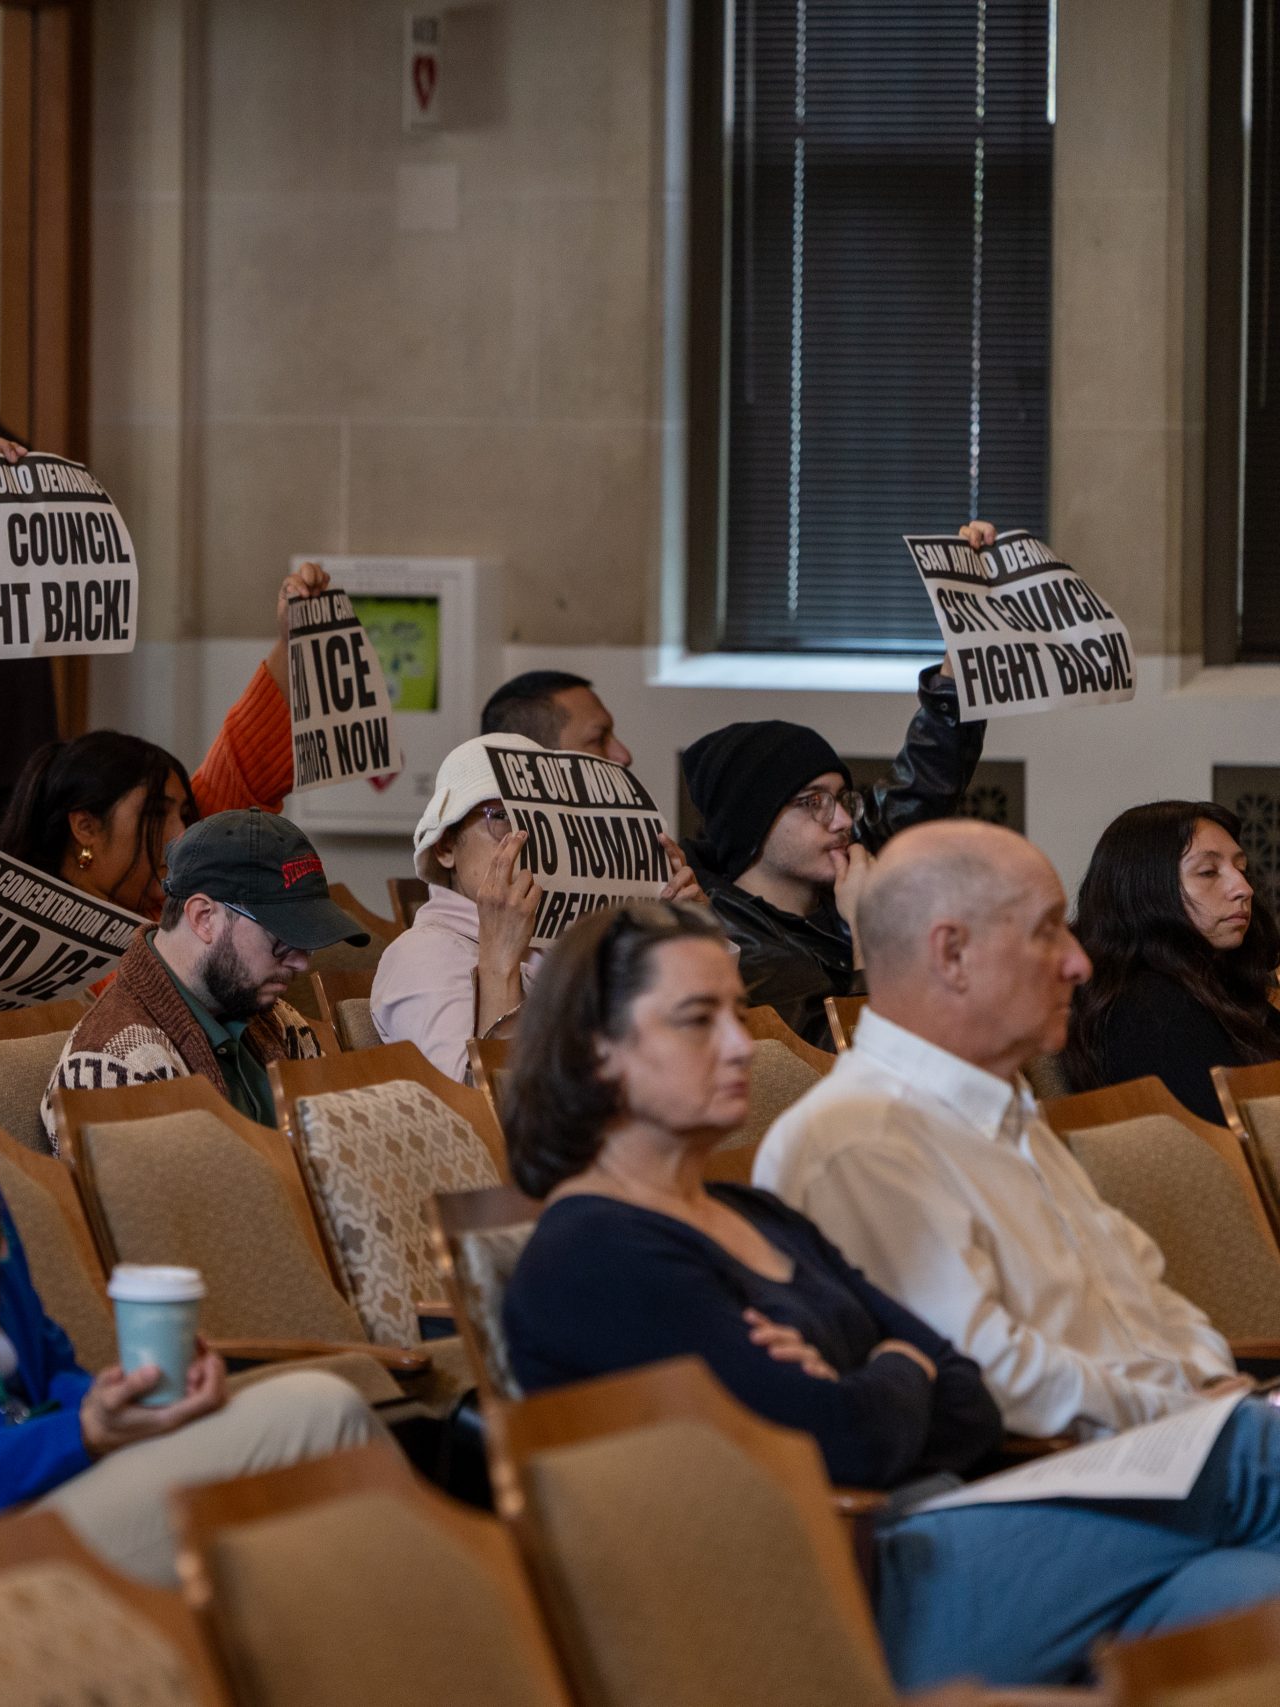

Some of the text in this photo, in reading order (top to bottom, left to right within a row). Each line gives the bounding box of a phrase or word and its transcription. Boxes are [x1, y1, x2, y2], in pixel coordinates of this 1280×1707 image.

[7, 512, 131, 567] COUNCIL
[914, 544, 951, 572] SAN
[41, 579, 131, 643] BACK!
[936, 577, 1115, 634] CITY COUNCIL
[311, 631, 377, 716] ICE
[957, 632, 1133, 708] FIGHT BACK!
[333, 716, 391, 777] NOW
[498, 752, 643, 806] ICE OUT NOW!
[512, 808, 669, 882] NO HUMAN
[2, 942, 112, 1001] ICE
